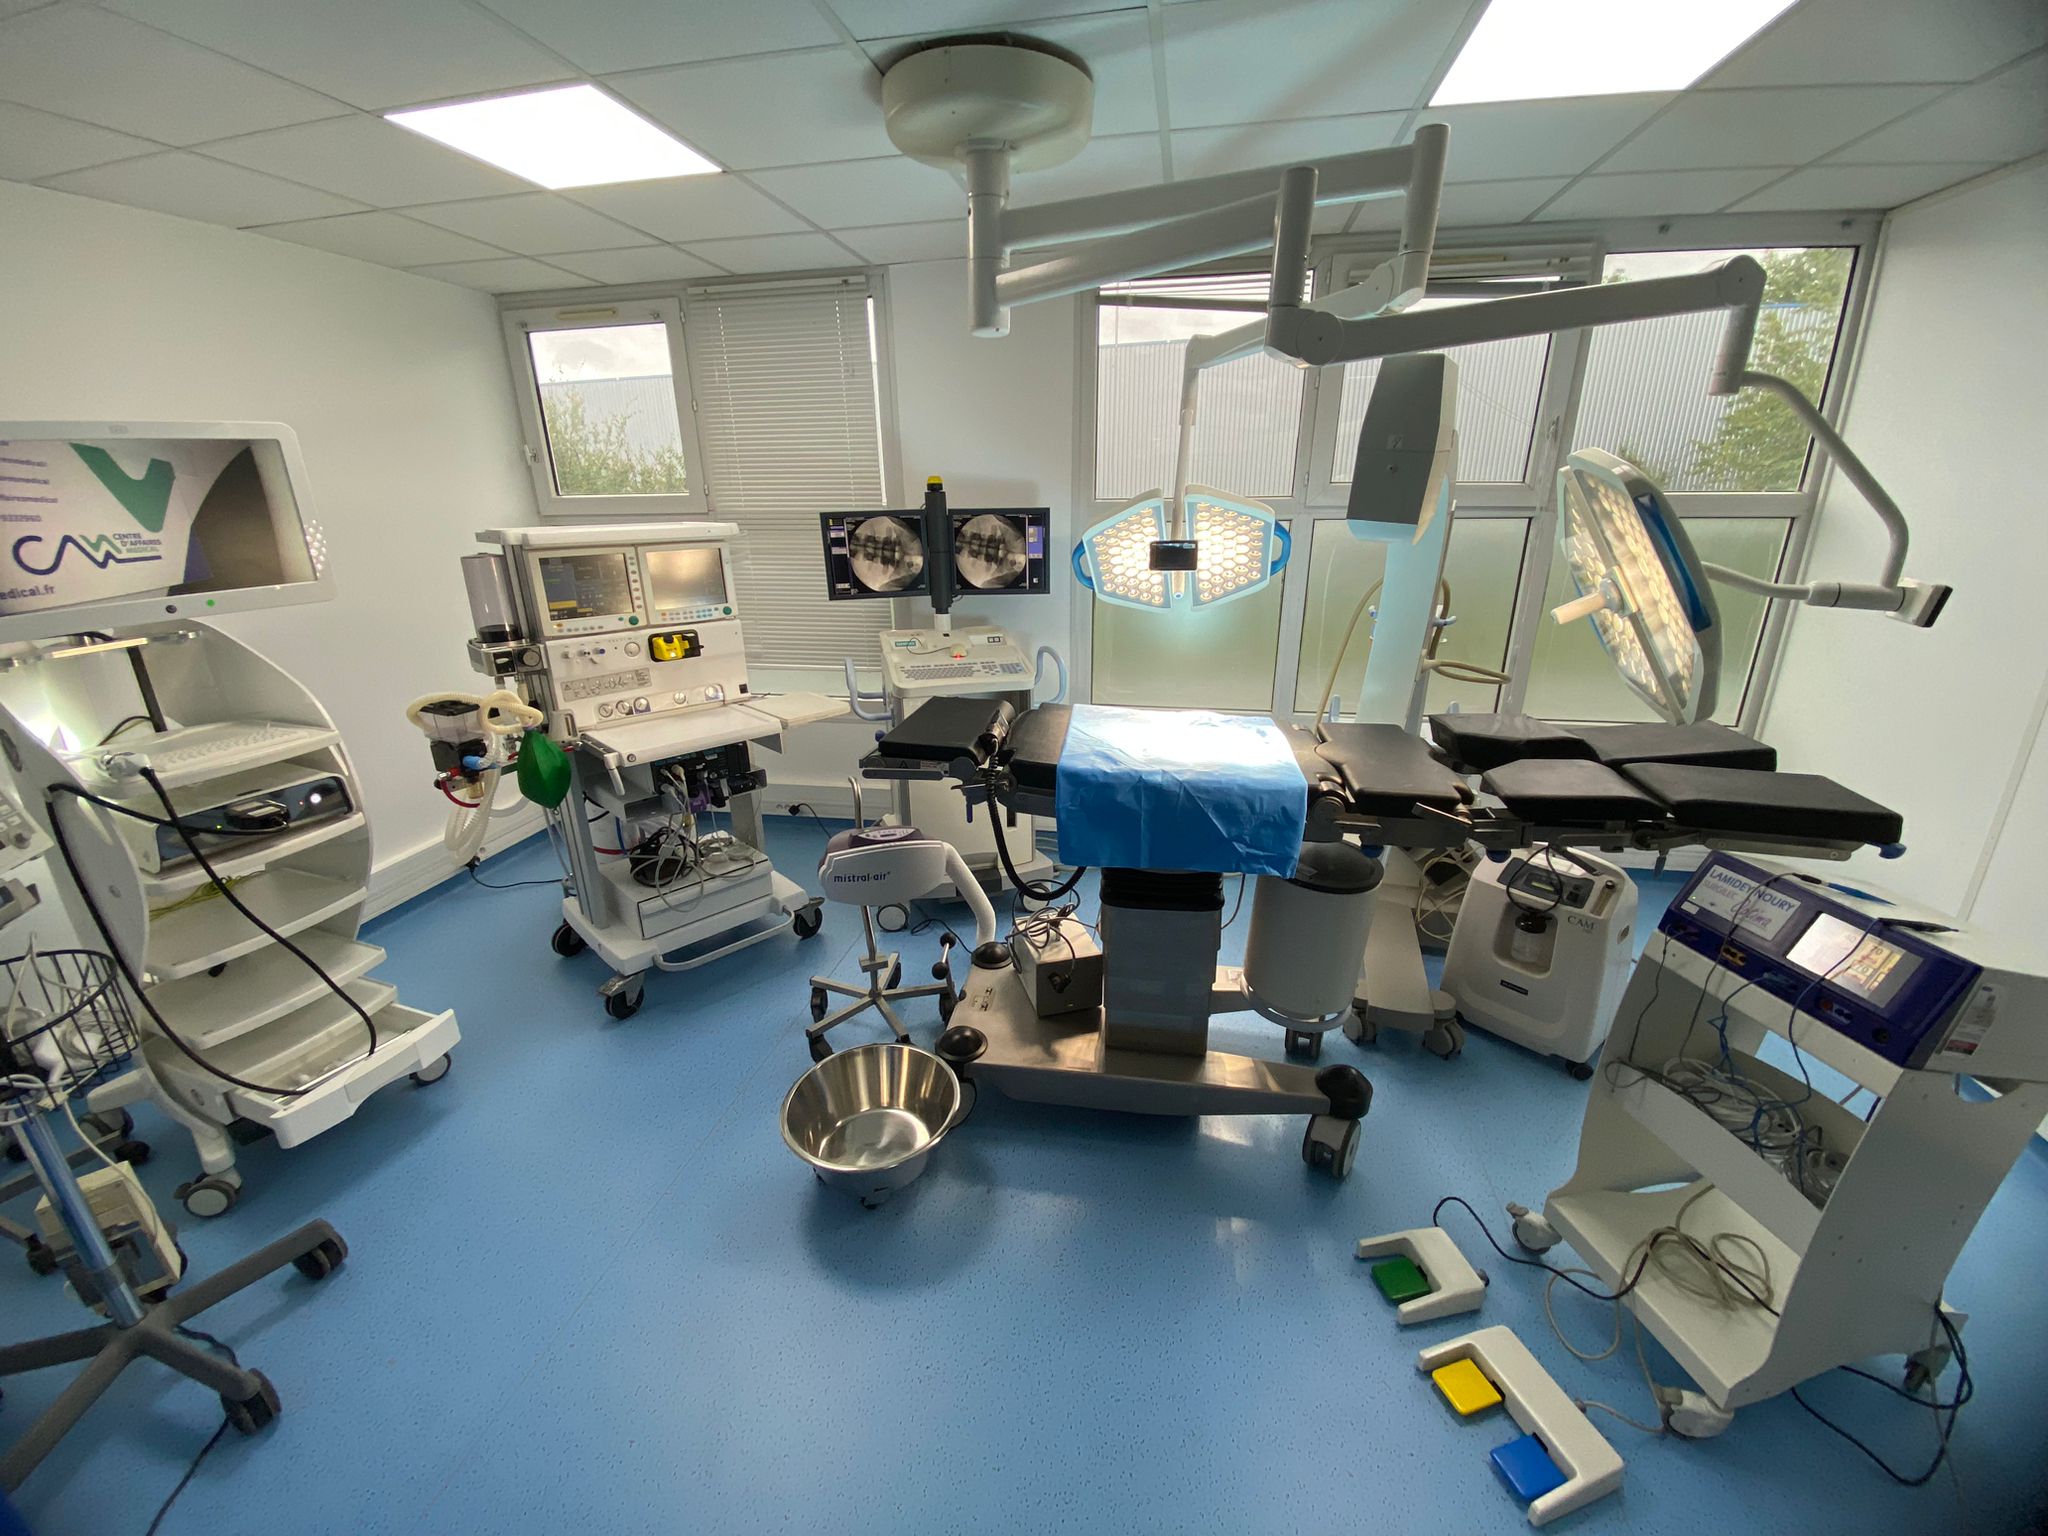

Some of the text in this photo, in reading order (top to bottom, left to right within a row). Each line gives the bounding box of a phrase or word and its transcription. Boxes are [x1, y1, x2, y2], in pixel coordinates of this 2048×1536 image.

[1709, 868, 1795, 912] LAMIDEY NOURY
[1567, 915, 1594, 930] CAM
